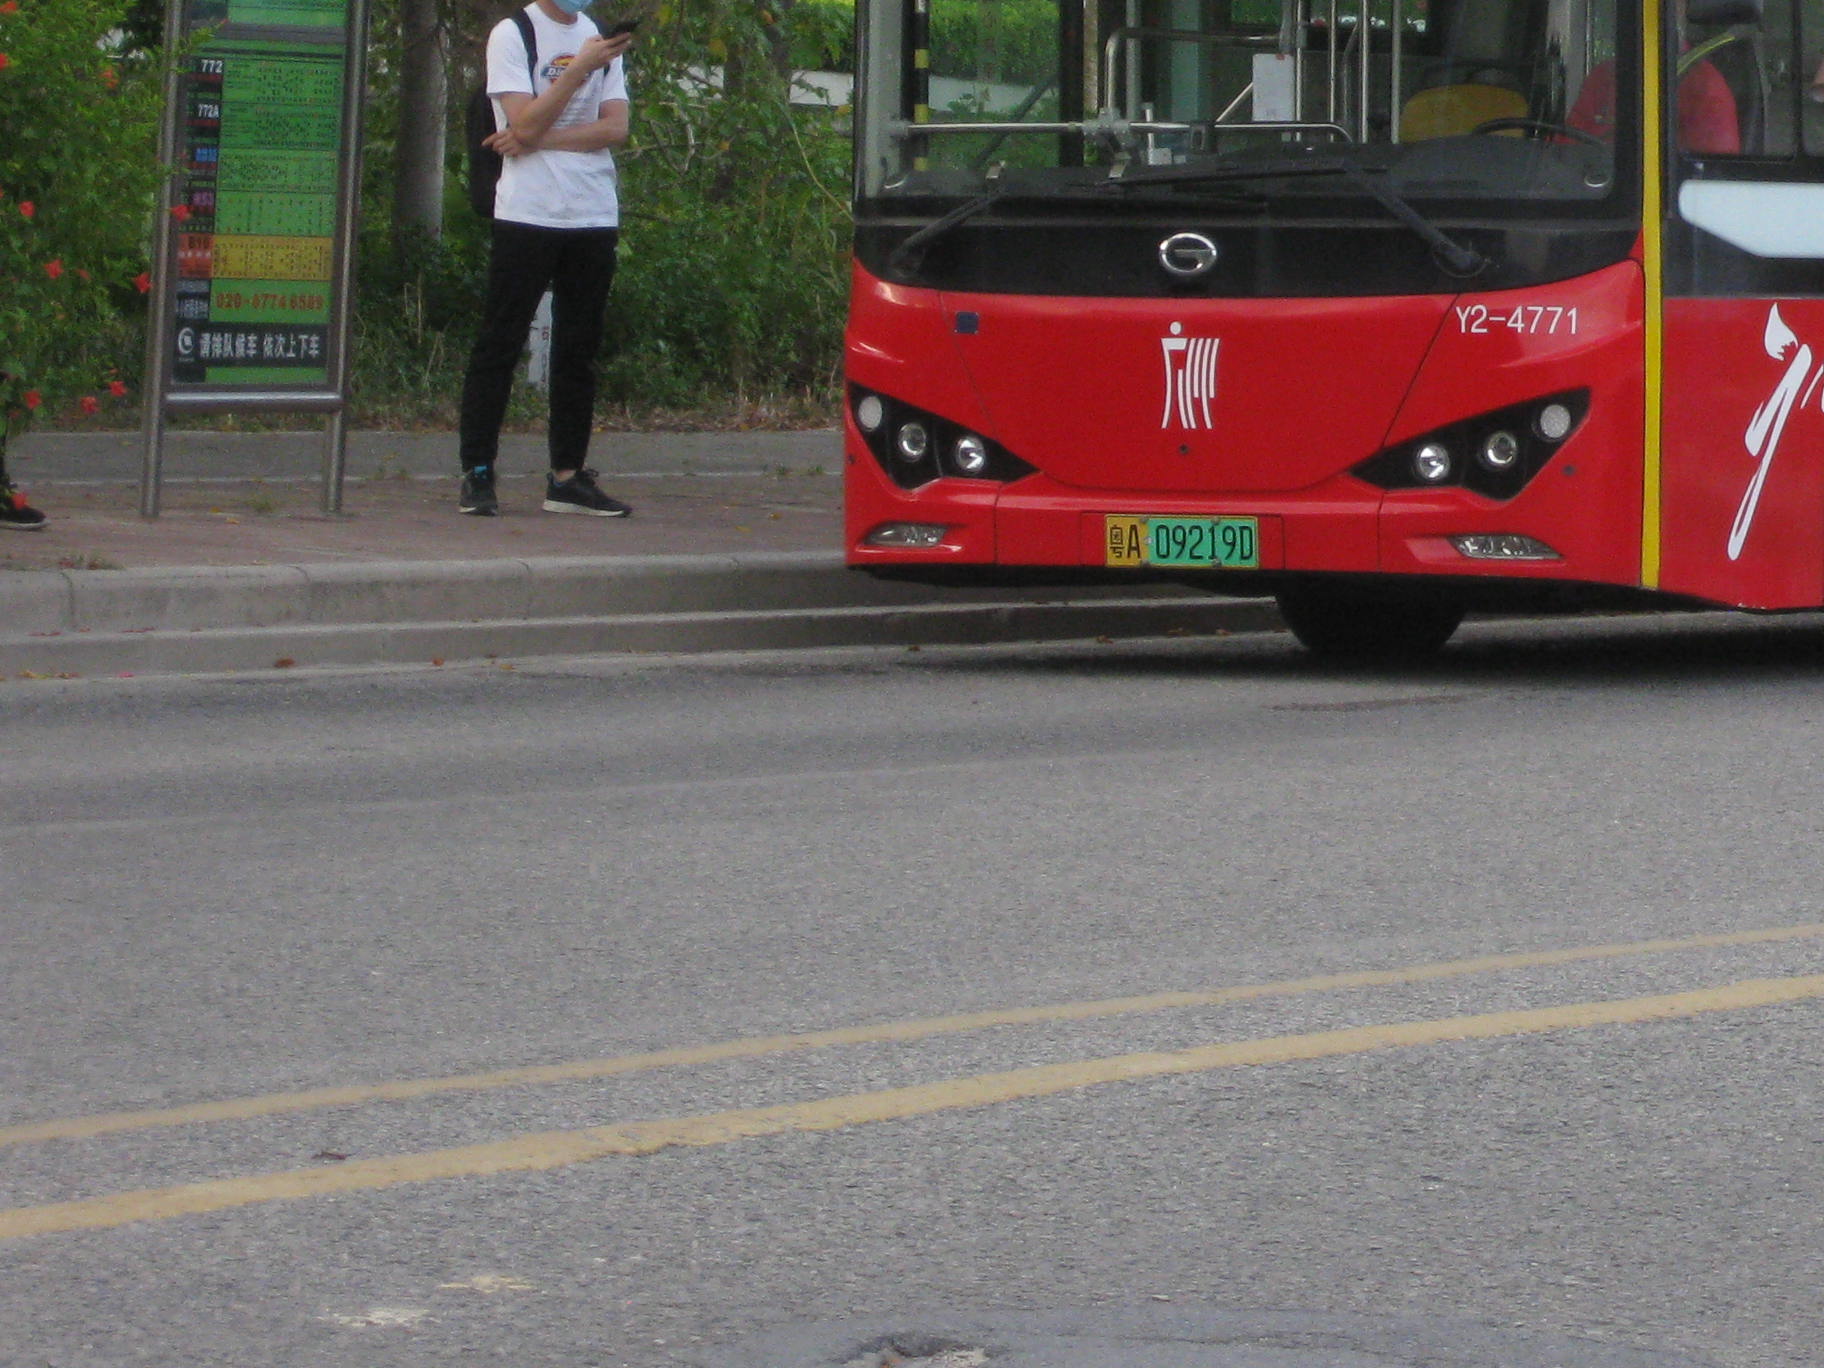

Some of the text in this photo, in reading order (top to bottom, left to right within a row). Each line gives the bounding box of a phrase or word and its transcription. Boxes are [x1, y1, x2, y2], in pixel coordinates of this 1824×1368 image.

[201, 59, 223, 73] 772
[197, 104, 220, 118] 772A
[1456, 305, 1577, 334] Y2-4771
[262, 333, 321, 359] 依次上下车
